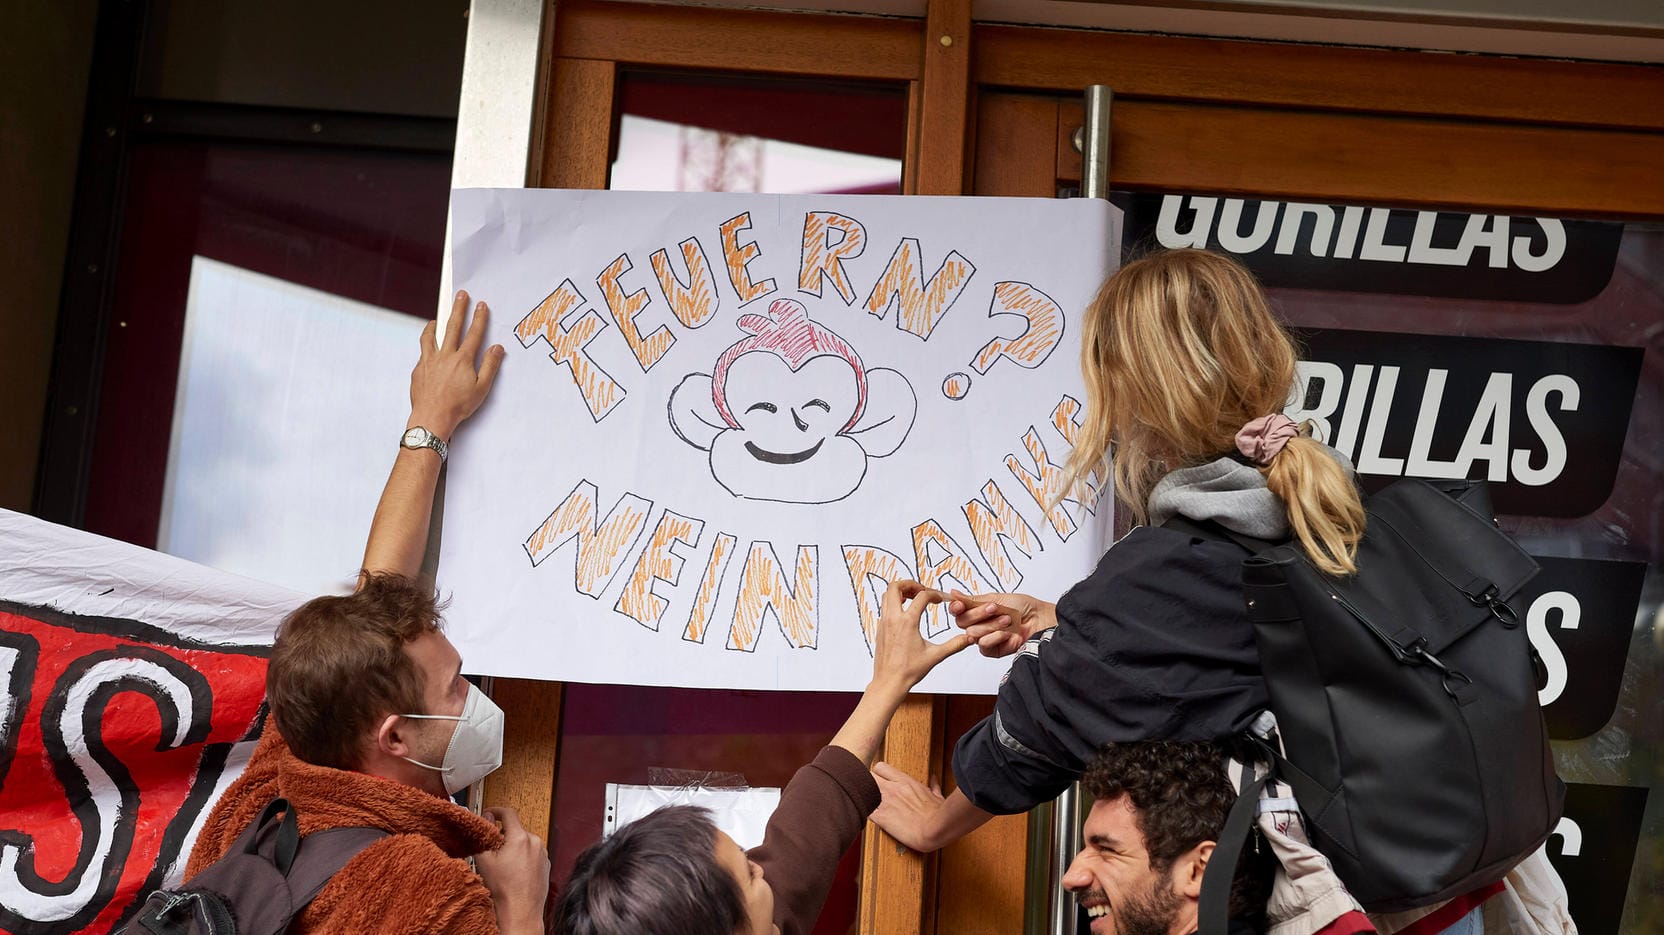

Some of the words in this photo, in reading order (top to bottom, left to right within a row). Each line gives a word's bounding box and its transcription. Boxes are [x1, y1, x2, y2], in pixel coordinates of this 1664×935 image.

[514, 211, 1066, 424] FEUERN?
[1282, 360, 1580, 486] RILLAS
[522, 479, 819, 653] NEIN
